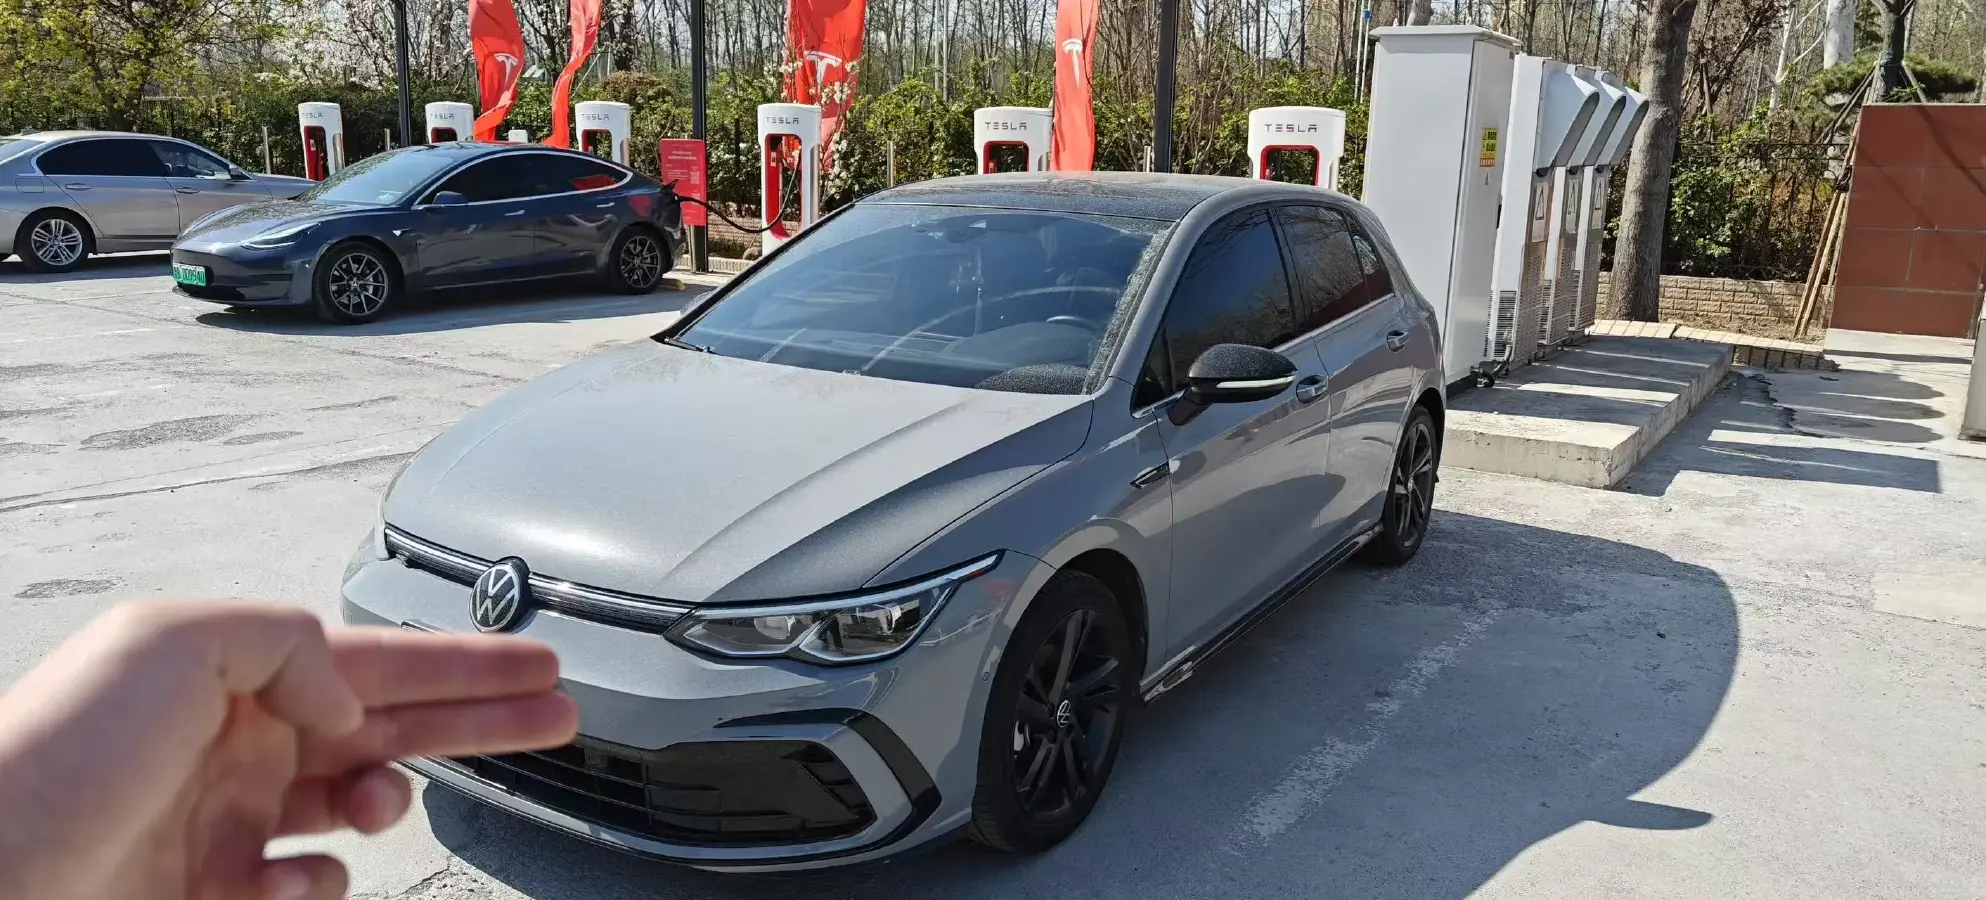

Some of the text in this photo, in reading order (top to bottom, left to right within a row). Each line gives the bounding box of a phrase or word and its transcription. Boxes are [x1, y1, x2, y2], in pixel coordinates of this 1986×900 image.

[765, 117, 799, 125] TESLA
[985, 122, 1027, 130] TESLA
[1264, 124, 1317, 133] TESLA
